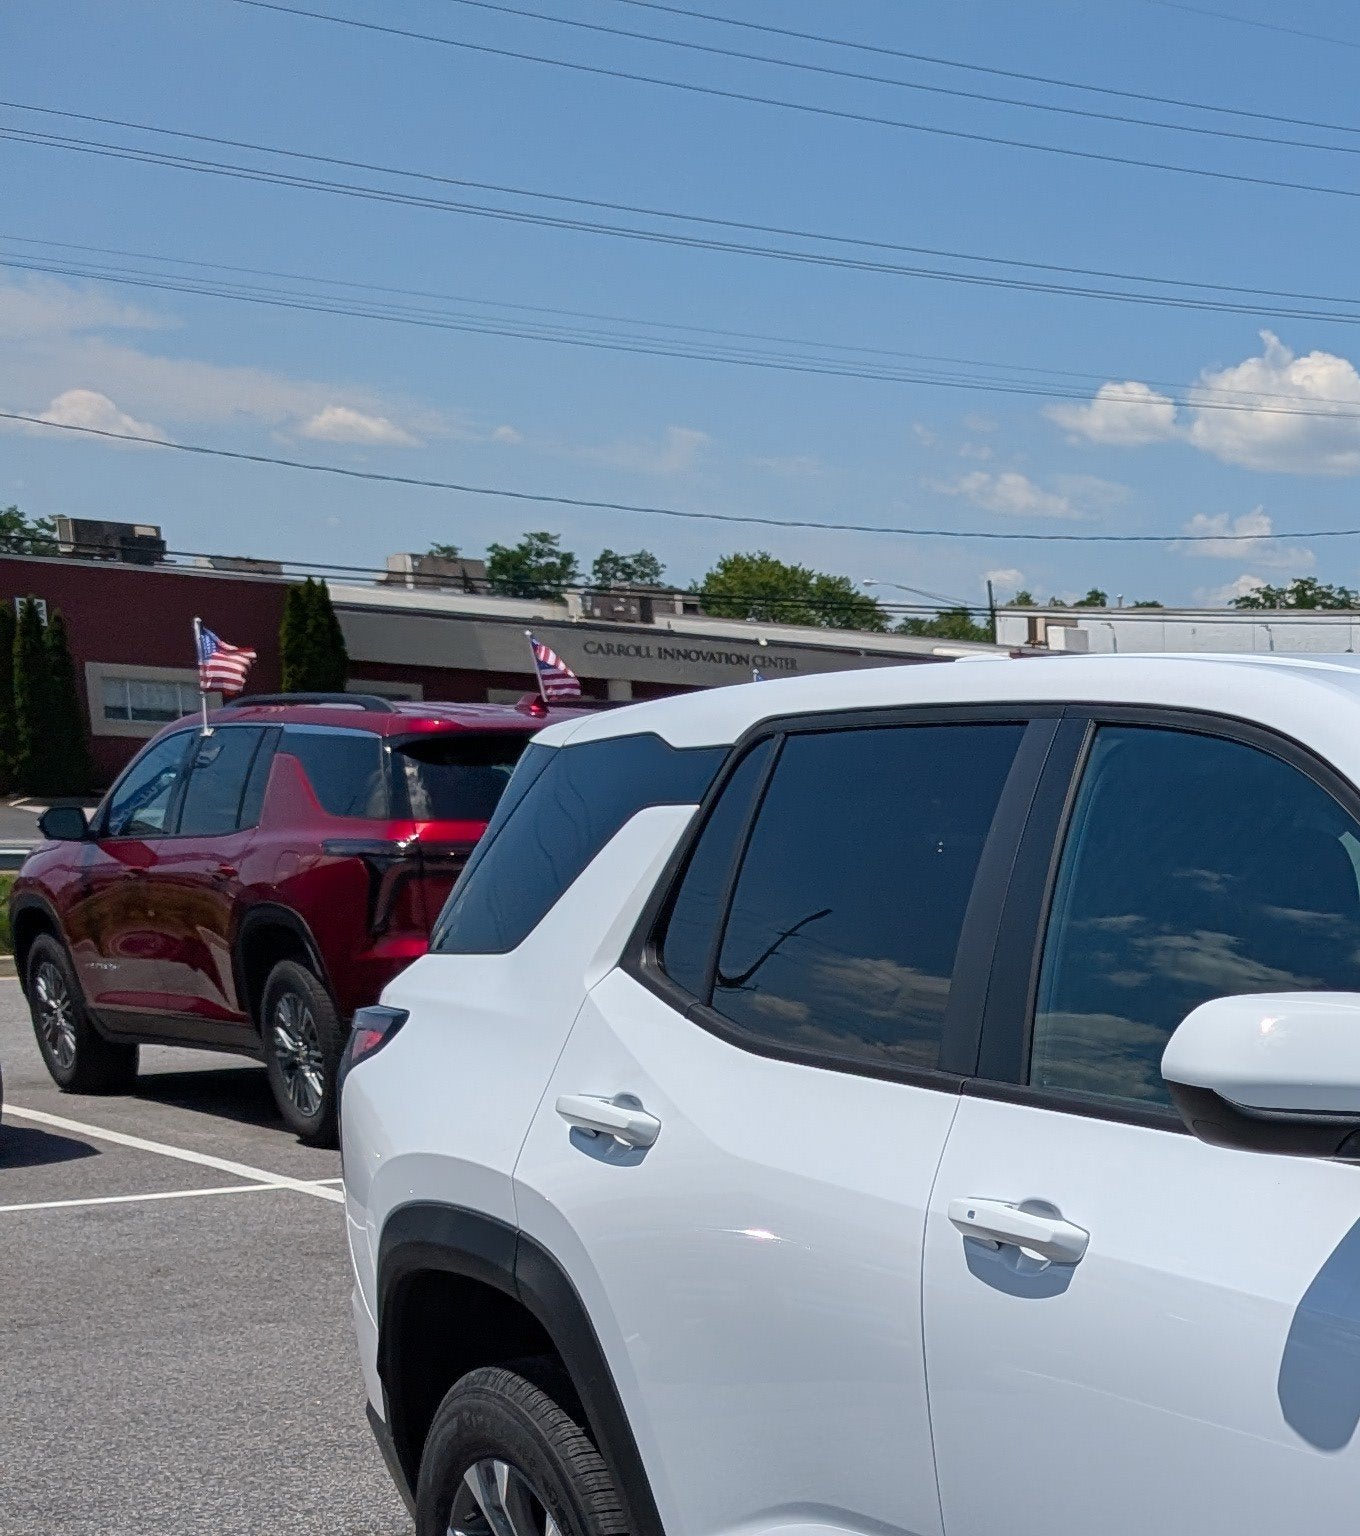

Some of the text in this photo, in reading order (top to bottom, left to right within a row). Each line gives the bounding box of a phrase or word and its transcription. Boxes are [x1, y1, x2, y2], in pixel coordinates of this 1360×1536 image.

[583, 641, 798, 670] CARROLL INNOVATION CENTER
